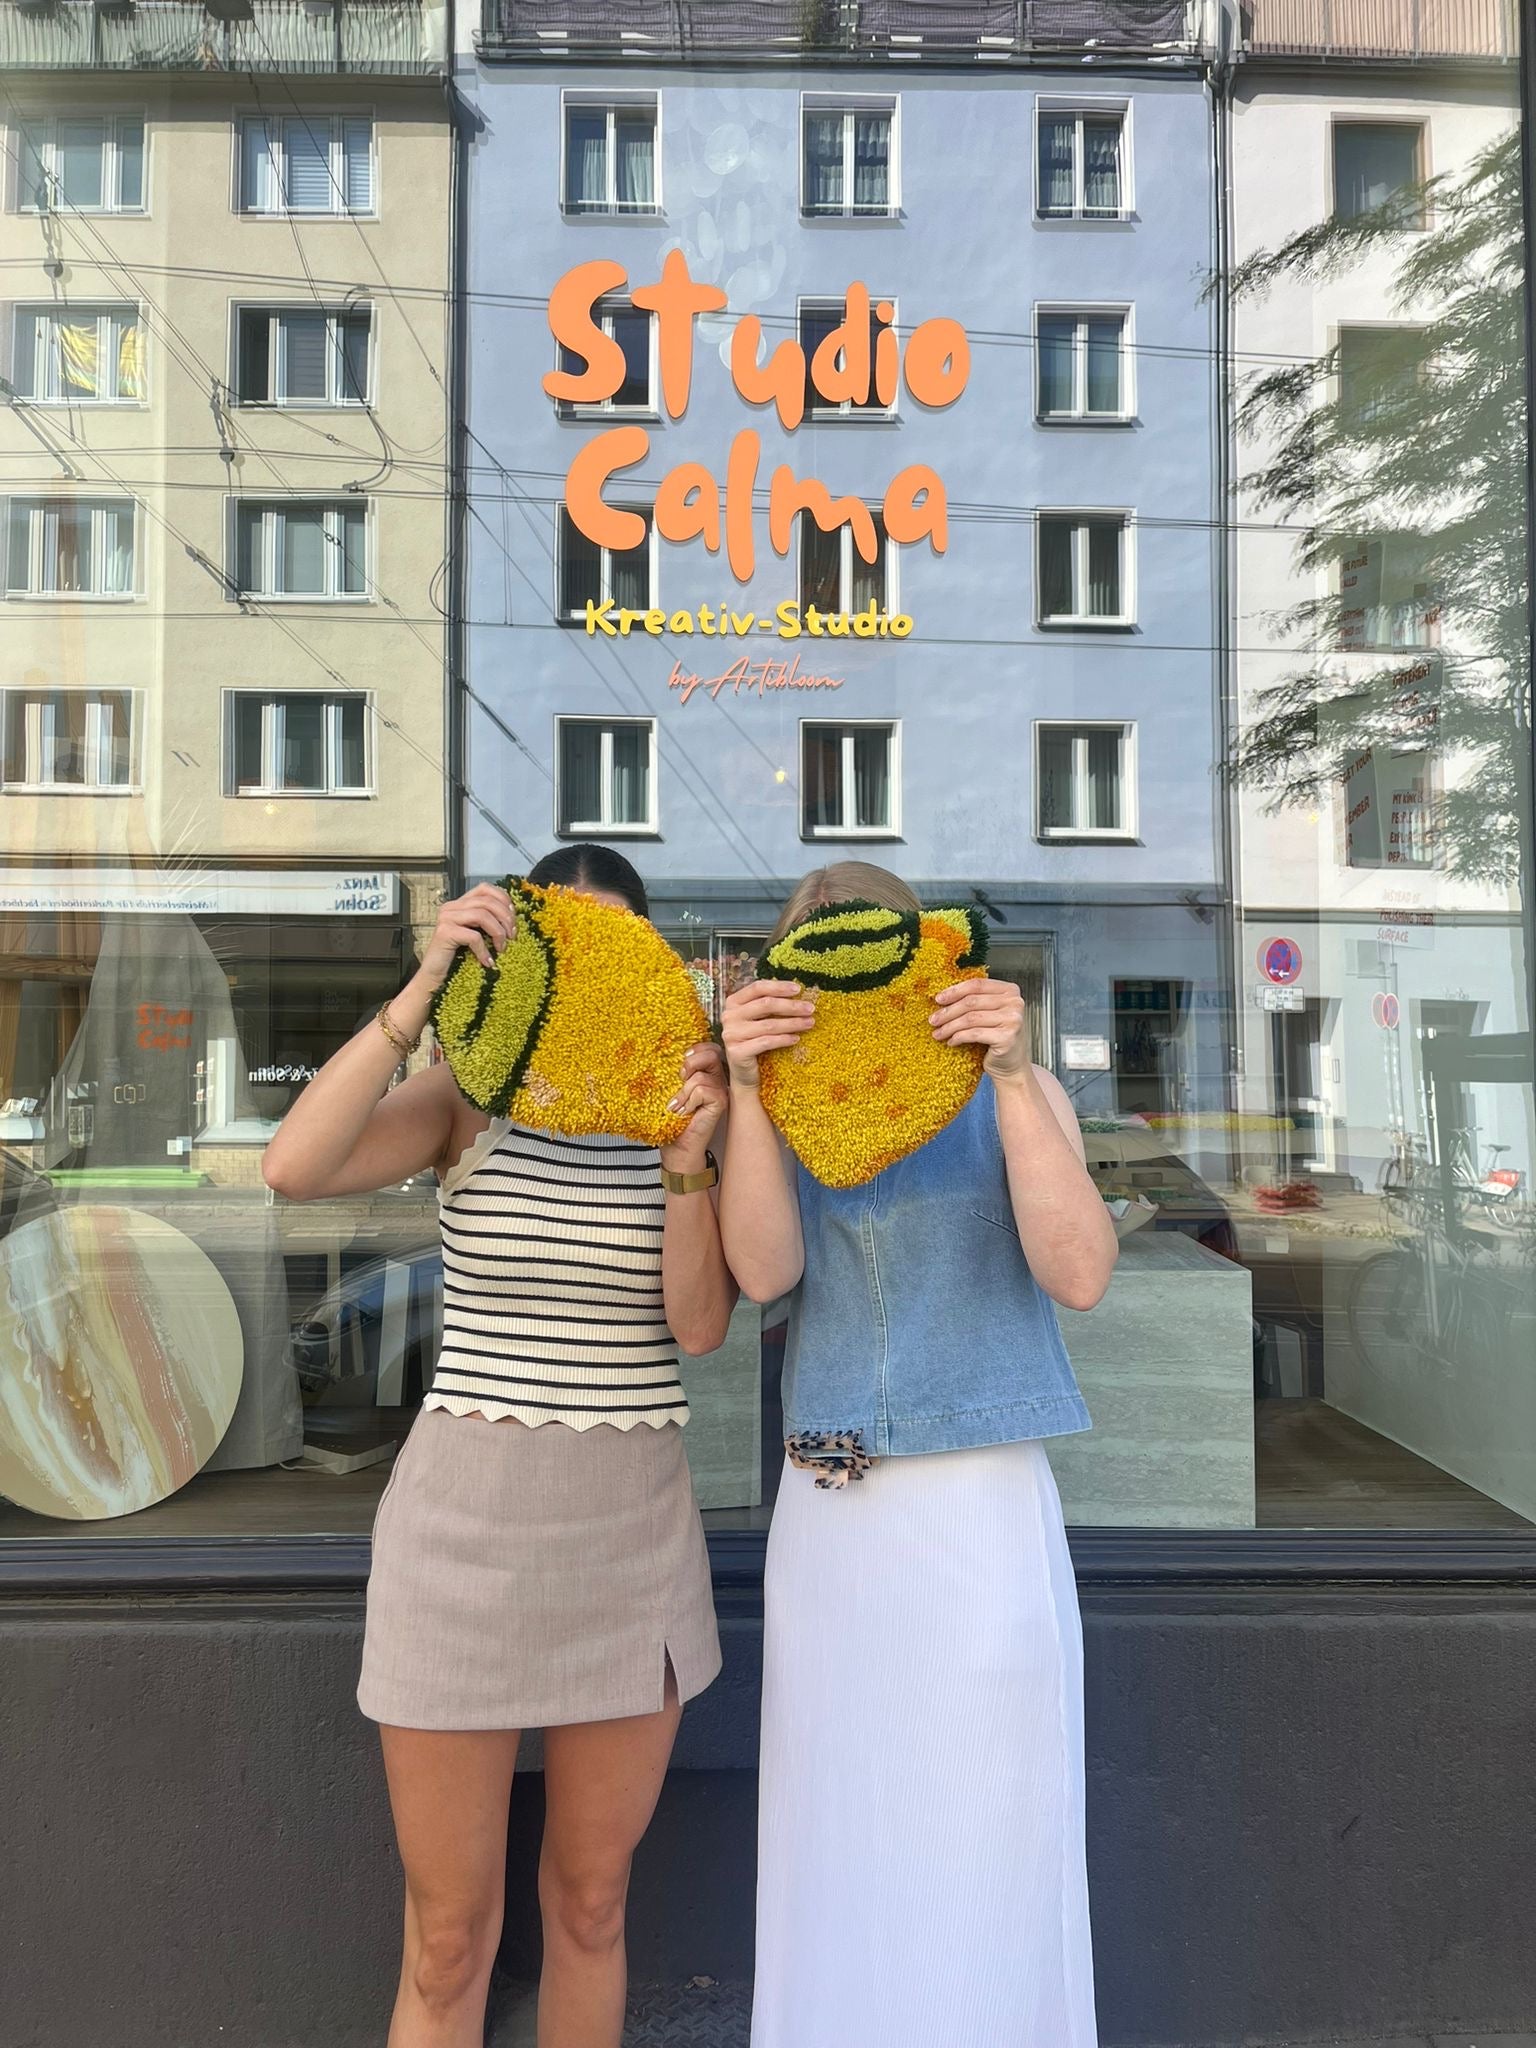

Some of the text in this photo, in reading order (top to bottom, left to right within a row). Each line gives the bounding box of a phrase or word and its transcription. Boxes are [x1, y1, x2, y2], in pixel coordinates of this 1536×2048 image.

[542, 248, 972, 430] Studio
[565, 427, 948, 581] Calma
[585, 598, 914, 638] Kreativ-Studio
[668, 651, 846, 704] by Artibloom
